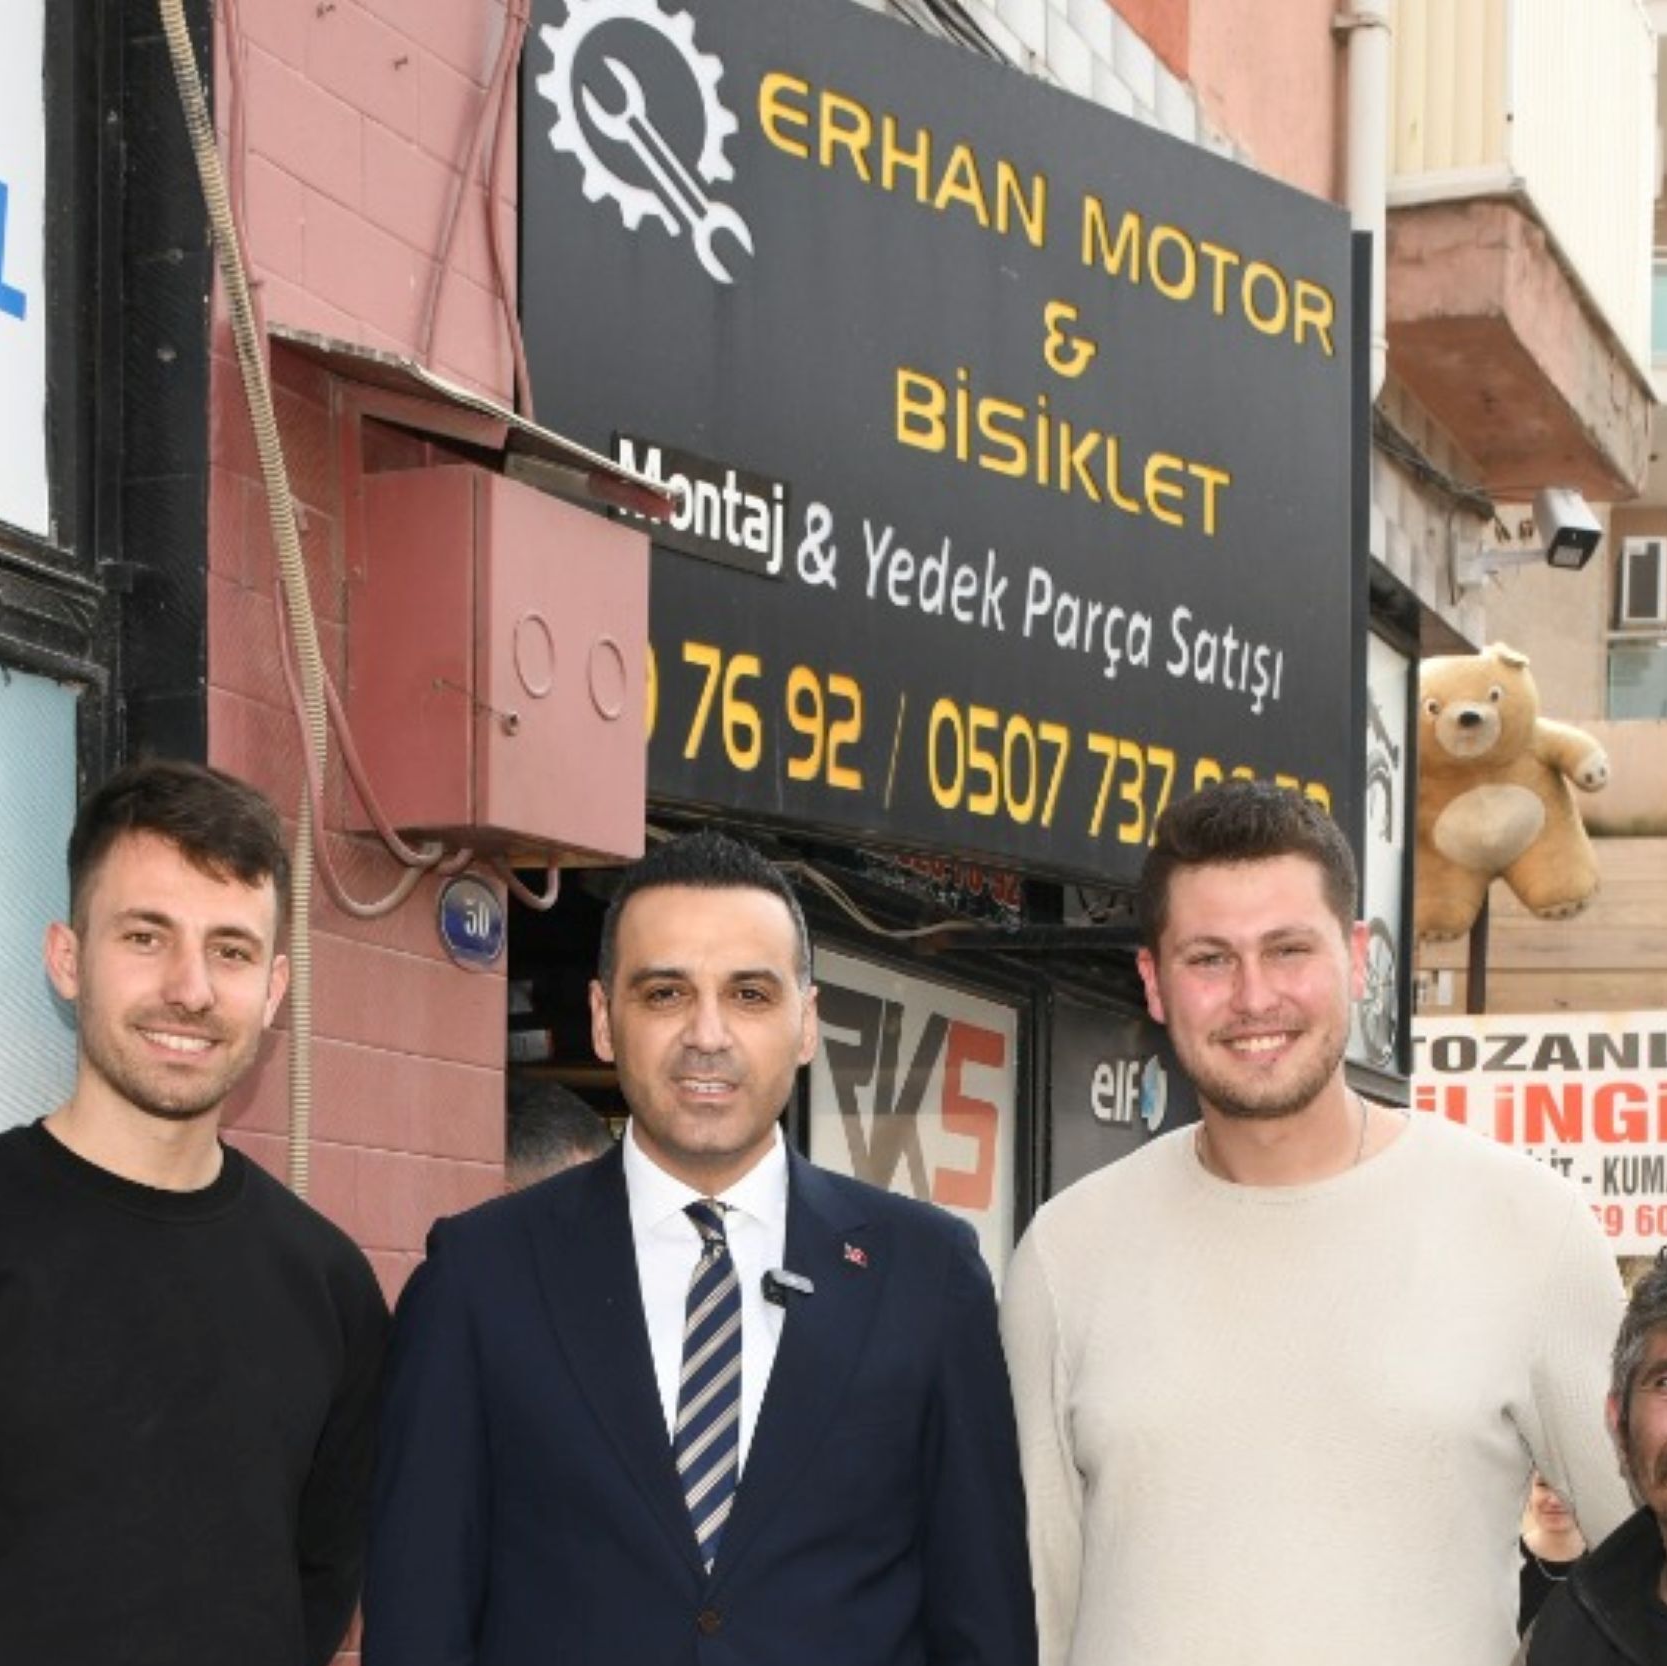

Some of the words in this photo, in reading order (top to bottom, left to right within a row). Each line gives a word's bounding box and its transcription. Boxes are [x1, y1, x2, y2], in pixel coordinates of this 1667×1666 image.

[758, 72, 1045, 248] ERHAN
[1082, 195, 1336, 356] MOTOR
[1044, 301, 1097, 377] &
[895, 366, 1230, 536] BİSİKLET
[619, 438, 784, 576] Montaj
[797, 502, 837, 587] &
[863, 520, 1005, 632] Yedek
[1024, 567, 1152, 680] Parça
[1167, 605, 1284, 714] Satışı
[682, 640, 764, 773] 76
[786, 664, 863, 791] 92
[926, 697, 1070, 826] 0507
[1087, 732, 1178, 847] 737
[1091, 1059, 1142, 1122] elf
